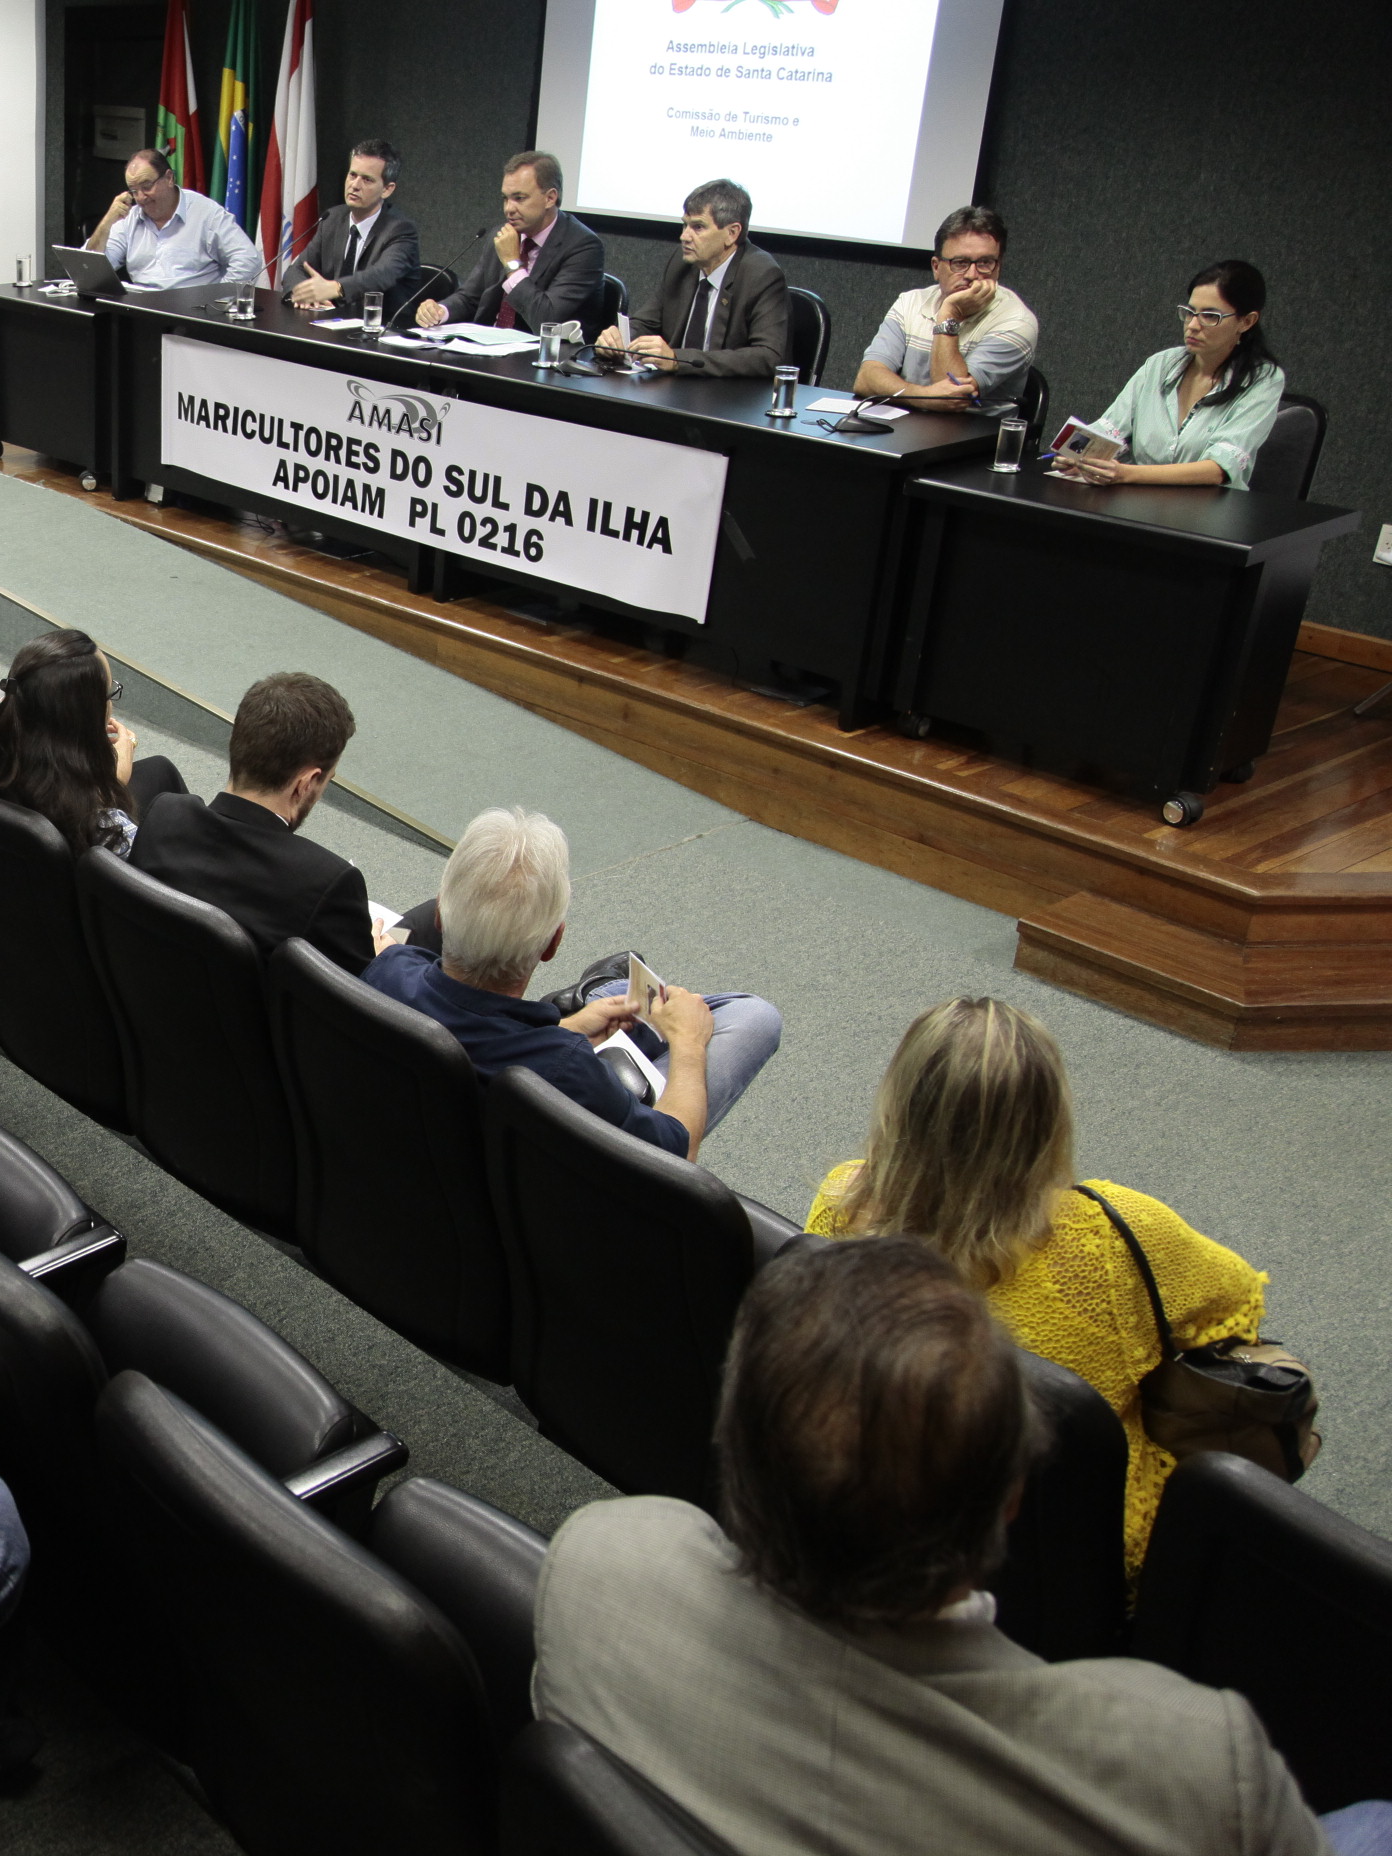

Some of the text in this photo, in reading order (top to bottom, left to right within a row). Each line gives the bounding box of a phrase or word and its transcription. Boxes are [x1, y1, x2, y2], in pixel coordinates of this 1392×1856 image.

[666, 40, 815, 59] Assembleia Legislativa
[649, 63, 833, 82] do Estado de Santa Catarina
[666, 107, 800, 126] Comissão de Turismo e
[690, 126, 773, 142] Meio Ambiente
[347, 399, 442, 446] AMASI
[177, 391, 673, 555] MARICULTORES DO SUL DA ILHA
[271, 458, 544, 563] APOIAM PL 0216
